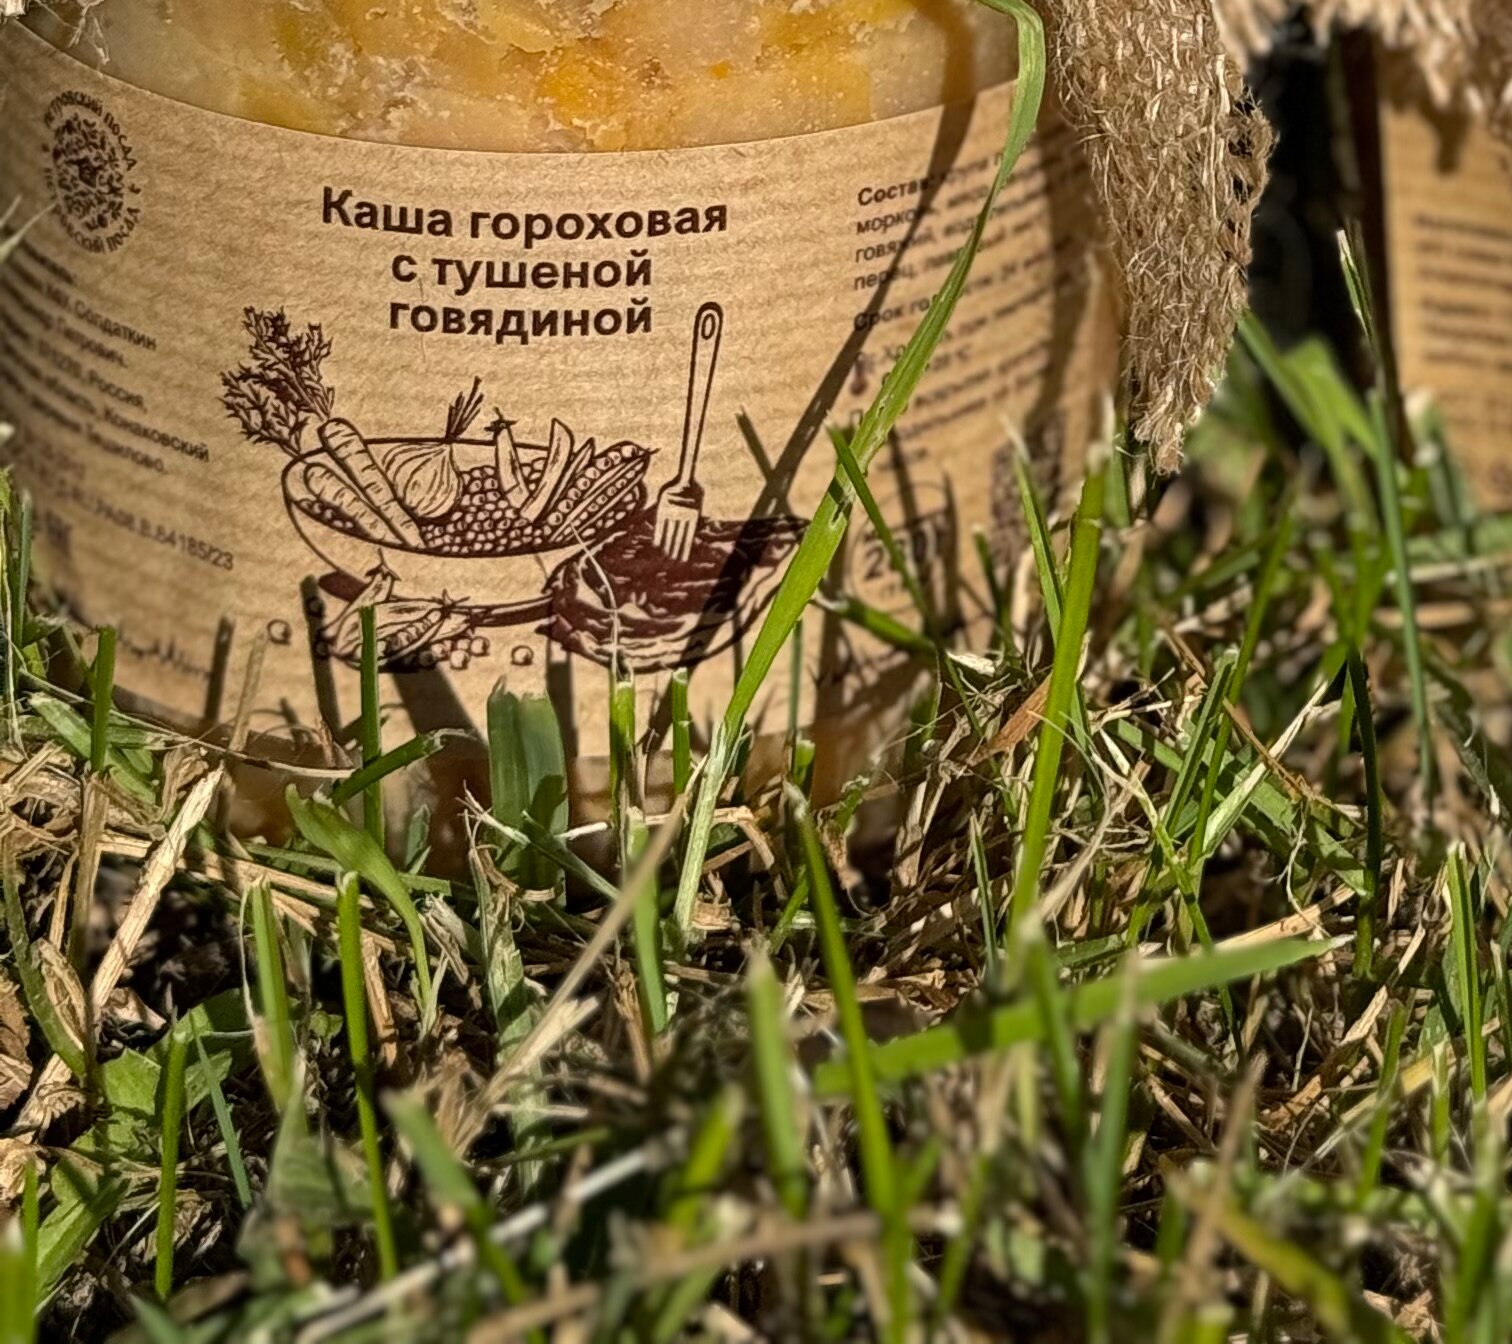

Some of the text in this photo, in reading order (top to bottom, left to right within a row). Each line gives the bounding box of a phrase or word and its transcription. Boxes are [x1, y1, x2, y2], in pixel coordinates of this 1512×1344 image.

[322, 185, 728, 250] Каша гороховая
[391, 248, 653, 297] с тушеной
[73, 299, 157, 352] Солдаткин
[389, 296, 653, 346] говядиной
[103, 407, 210, 463] Конаковский
